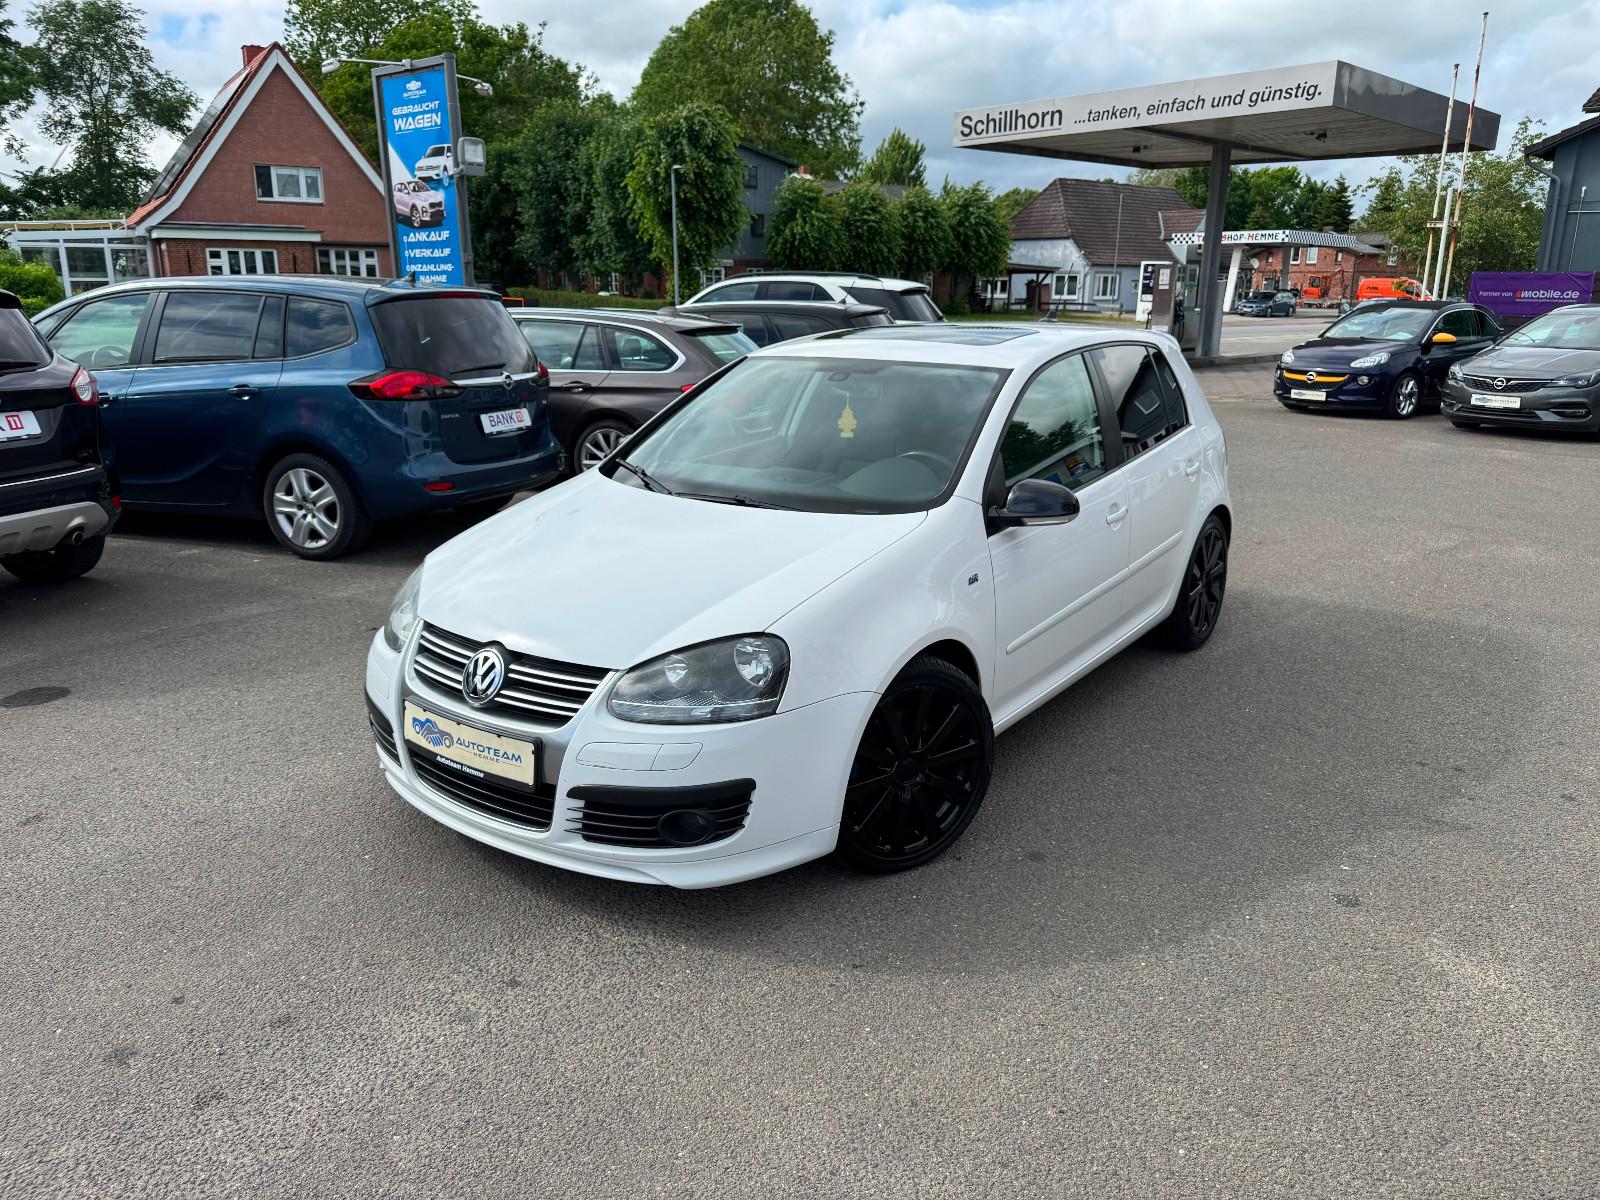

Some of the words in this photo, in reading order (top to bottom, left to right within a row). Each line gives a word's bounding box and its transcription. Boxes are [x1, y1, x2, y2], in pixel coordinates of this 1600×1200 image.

[392, 101, 440, 115] GEBRAUCHT
[960, 109, 1063, 137] Schillhorn
[1074, 105, 1141, 124] ...tanken,
[1146, 95, 1205, 115] einfach
[1211, 89, 1245, 108] und
[1248, 81, 1322, 107] günstig.
[393, 112, 441, 131] WAGEN
[408, 231, 450, 242] ANKAUF
[408, 248, 451, 257] VERKAUF
[419, 275, 447, 283] NAHME
[1521, 289, 1580, 299] mobile.de
[488, 411, 516, 428] BANK
[456, 737, 523, 764] AUTOTEAM
[473, 752, 501, 764] HEMME
[436, 755, 462, 771] Autoteam
[462, 763, 485, 778] Hemme
